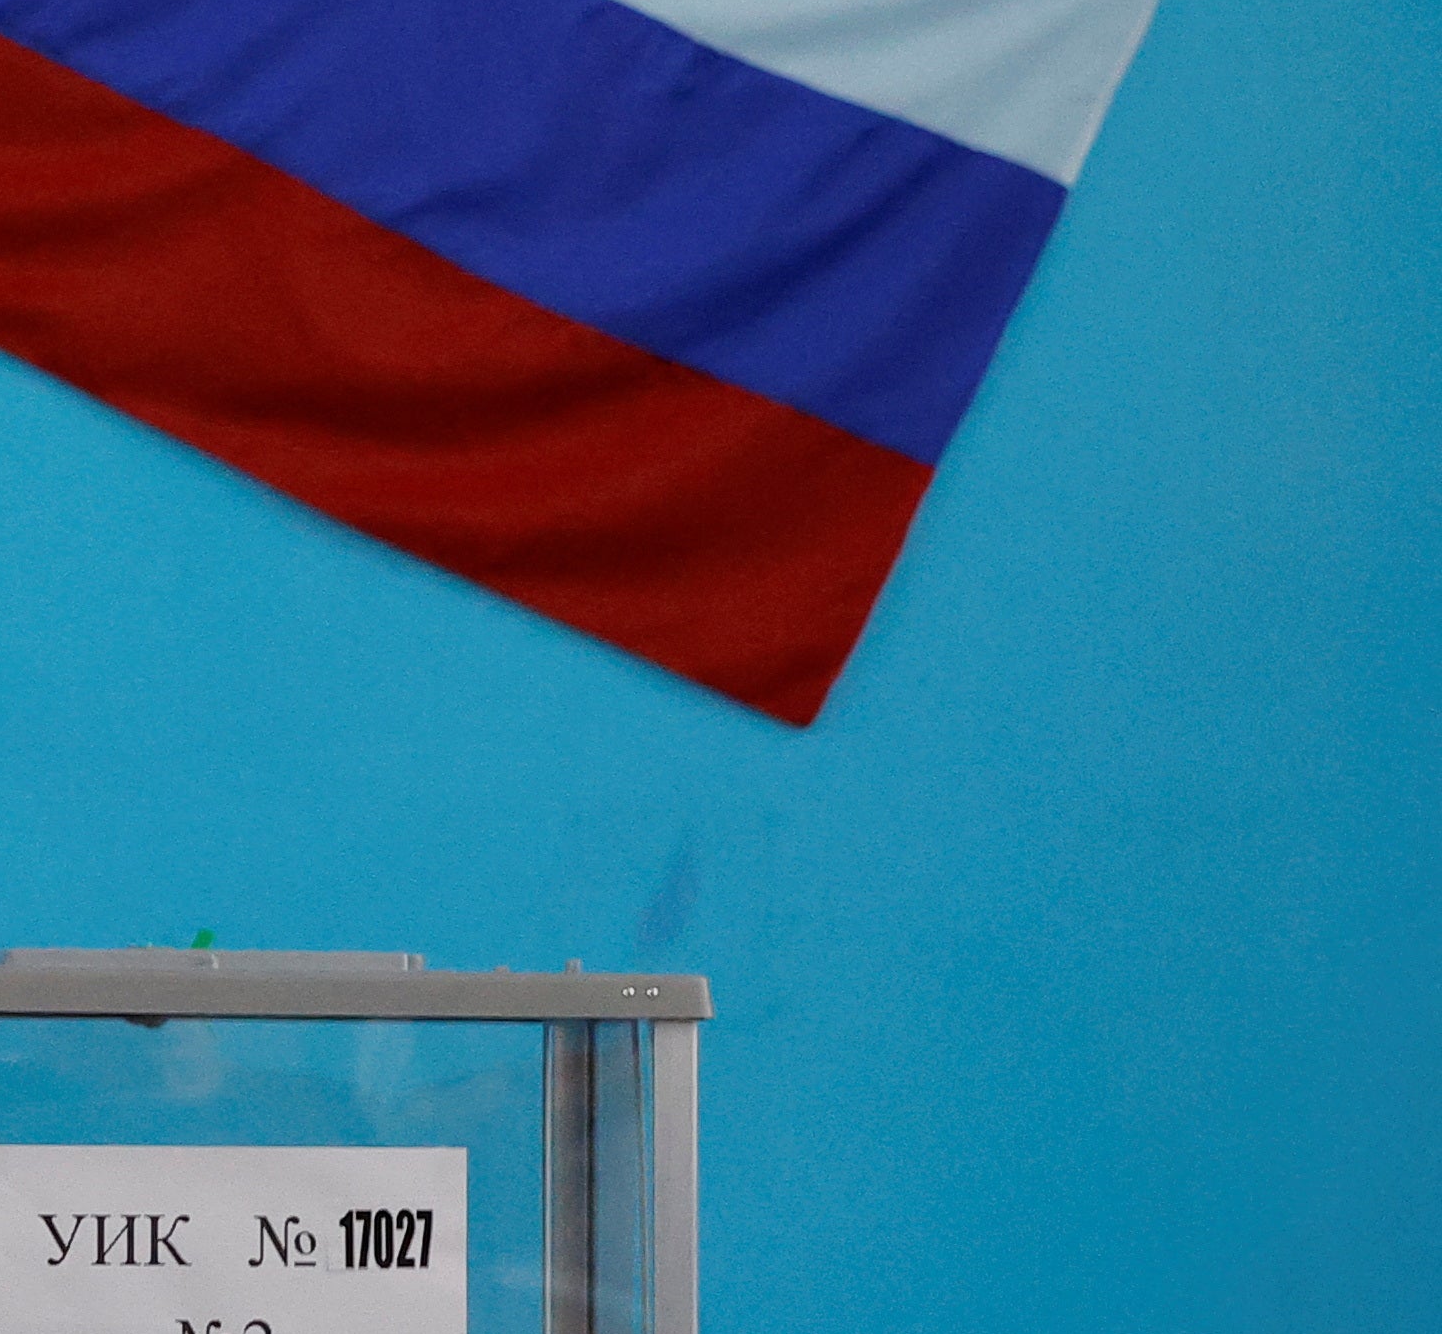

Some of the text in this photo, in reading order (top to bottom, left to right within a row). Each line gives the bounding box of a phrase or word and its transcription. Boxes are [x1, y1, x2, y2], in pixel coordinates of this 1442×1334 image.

[38, 1208, 435, 1270] УИК № 17027
